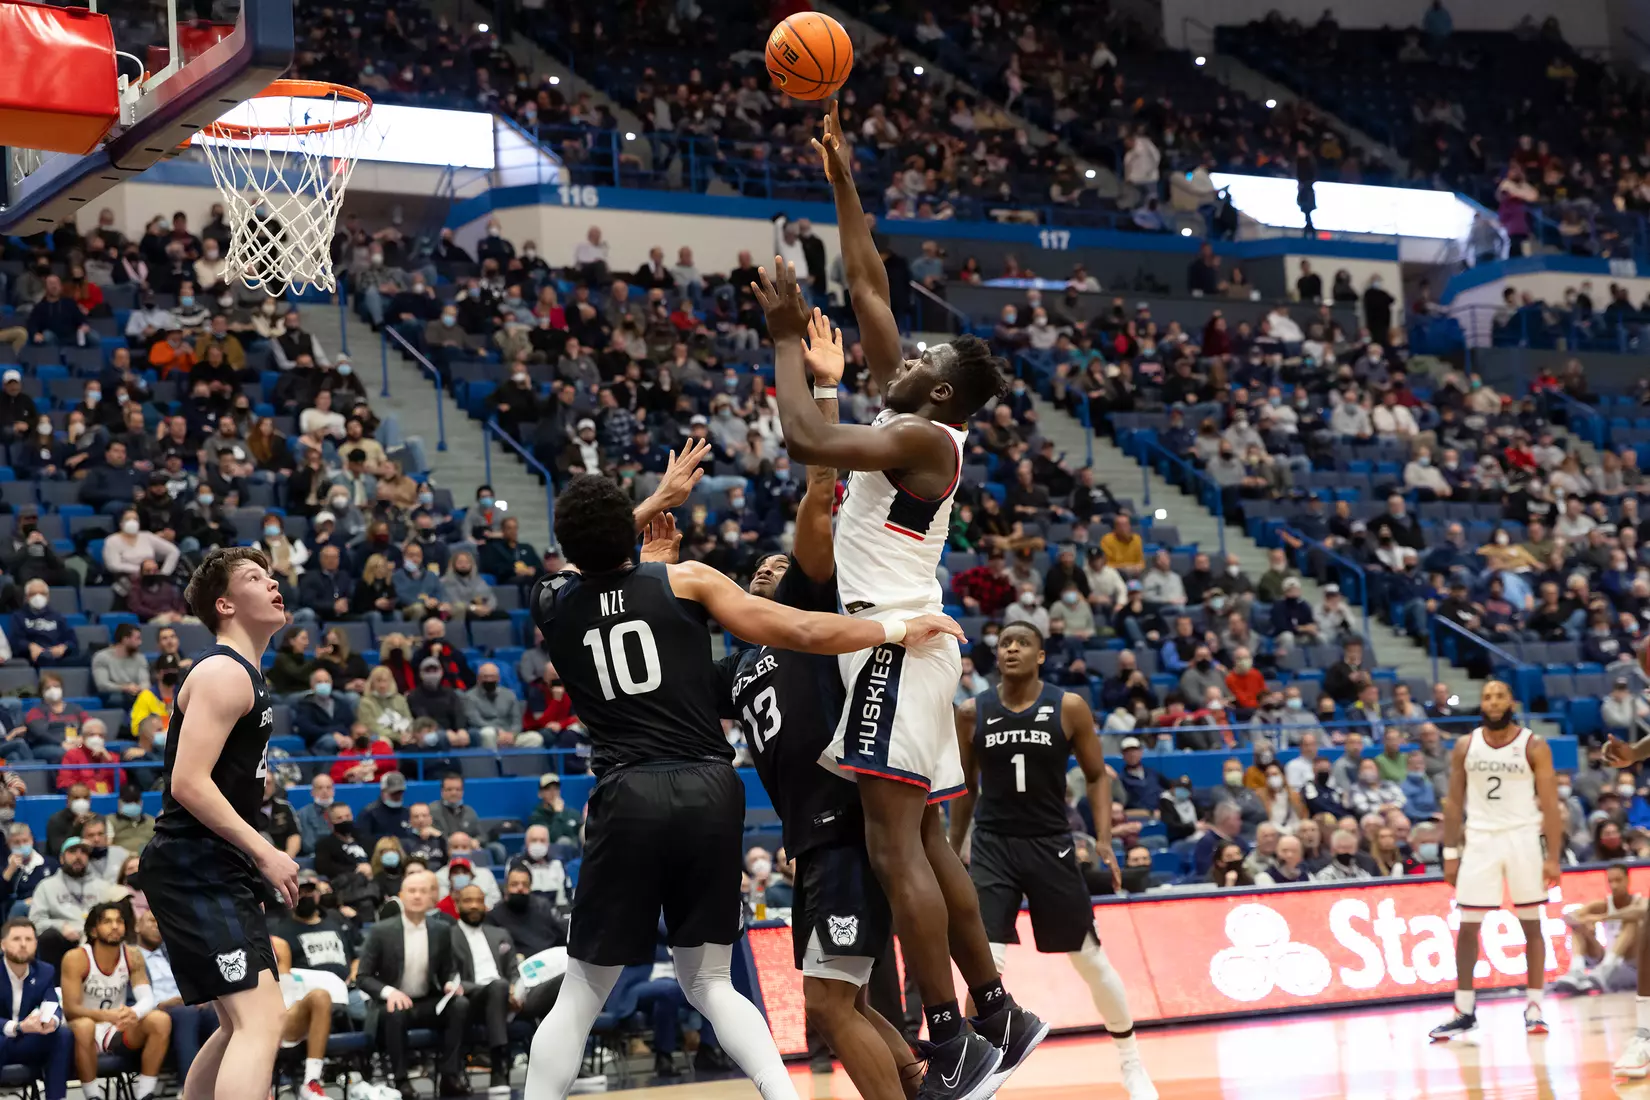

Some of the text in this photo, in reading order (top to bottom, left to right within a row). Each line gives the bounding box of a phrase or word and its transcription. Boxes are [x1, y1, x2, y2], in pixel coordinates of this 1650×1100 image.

[771, 27, 800, 66] ELITE
[557, 184, 599, 207] 116
[1038, 229, 1070, 250] 117
[599, 589, 626, 617] NZE
[582, 619, 662, 701] 10
[858, 647, 893, 756] HUSKIES
[742, 685, 782, 754] 13
[985, 729, 1053, 748] BUTLER
[1010, 753, 1027, 793] 1
[1467, 760, 1526, 775] UCONN
[1486, 776, 1502, 800] 2
[985, 987, 1003, 1002] 23
[932, 1010, 952, 1025] 23
